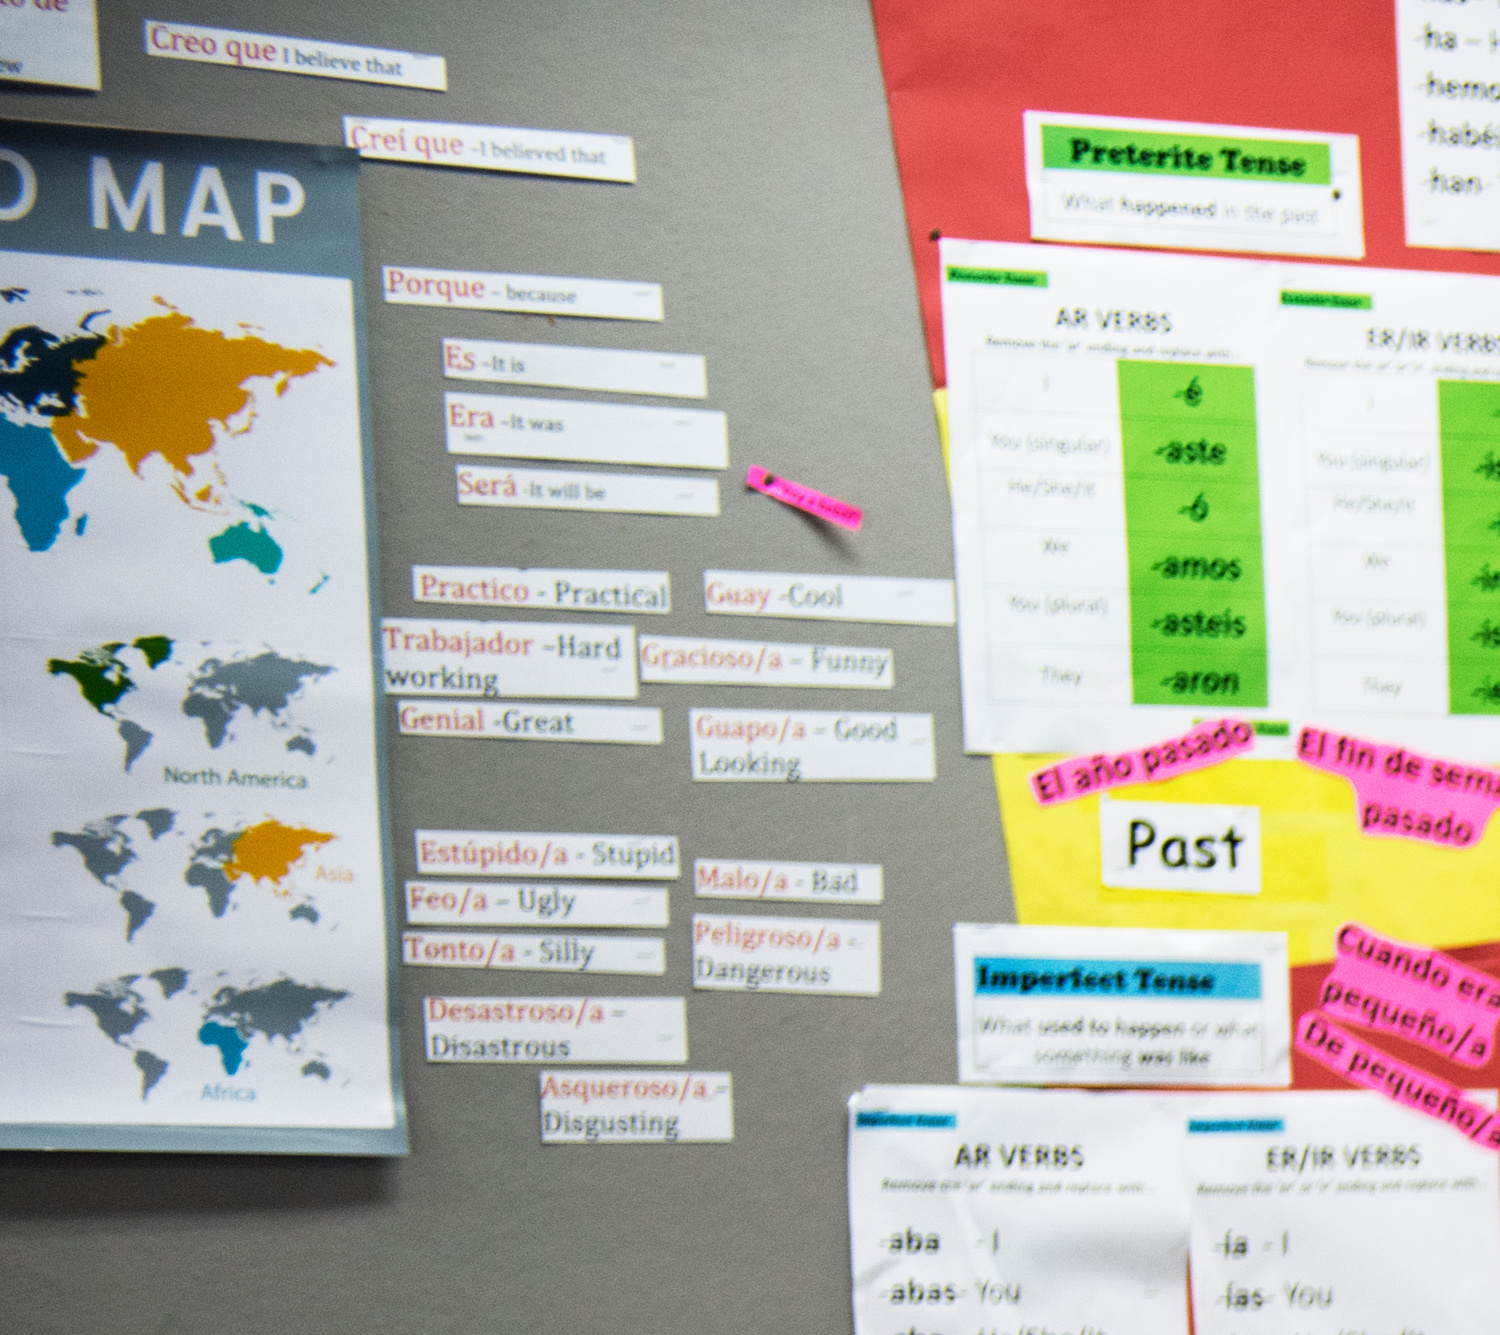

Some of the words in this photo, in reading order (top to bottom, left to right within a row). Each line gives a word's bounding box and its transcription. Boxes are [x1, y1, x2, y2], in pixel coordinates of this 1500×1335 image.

[149, 25, 216, 55] Creo
[226, 39, 277, 66] que
[283, 47, 289, 63] I
[296, 49, 360, 72] believe
[365, 57, 403, 76] that
[351, 126, 407, 152] Creí
[415, 134, 463, 159] que
[494, 139, 567, 164] believed
[569, 143, 606, 166] that
[1070, 137, 1212, 173] Preterite
[1221, 145, 1308, 178] Tense
[90, 154, 306, 245] MAP
[386, 269, 486, 303] Porque
[505, 283, 577, 304] because
[1056, 306, 1092, 332] AR
[1097, 308, 1173, 335] VERBS
[1365, 326, 1430, 356] ER/IR
[445, 344, 476, 371] Es
[510, 356, 525, 373] is
[450, 403, 495, 428] Era
[530, 416, 564, 432] was
[457, 470, 518, 498] Será
[548, 484, 580, 501] will
[585, 486, 606, 501] be
[420, 573, 530, 602] Practico
[554, 580, 666, 608] Practical
[707, 578, 771, 613] Guay
[382, 626, 534, 660] Trabajador
[641, 642, 782, 675] Gracioso/a
[812, 647, 889, 679] Funny
[385, 664, 499, 696] working
[400, 706, 484, 731] Genial
[696, 714, 806, 744] Guapo/a
[834, 716, 897, 742] Good
[700, 751, 802, 782] Looking
[1035, 768, 1066, 802] El
[1072, 752, 1134, 791] año
[1142, 720, 1254, 785] pasado
[1302, 728, 1332, 760] El
[1338, 736, 1374, 768] fin
[1385, 746, 1422, 779] de
[164, 764, 216, 788] North
[225, 766, 308, 791] America
[1360, 799, 1474, 846] pasado
[419, 838, 569, 870] Estúpido/a
[592, 841, 676, 871] Stupid
[1126, 817, 1246, 871] Past
[314, 862, 356, 885] Asia
[696, 864, 788, 898] Malo/a
[811, 869, 858, 896] Bad
[409, 886, 488, 917] Feo/a
[518, 888, 576, 917] Ugly
[404, 935, 516, 968] Tonto/a
[538, 938, 594, 972] Silly
[693, 920, 842, 958] Peligroso/a
[1337, 926, 1452, 983] Cuando
[695, 958, 832, 989] Dangerous
[977, 964, 1124, 996] Imperfect
[1134, 968, 1214, 994] Tense
[427, 996, 604, 1027] Desastroso/a
[1321, 979, 1489, 1060] pequeño/a
[431, 1034, 571, 1059] Disastrous
[1304, 1018, 1346, 1052] De
[200, 1081, 258, 1103] Africa
[541, 1072, 708, 1105] Asqueroso/a
[542, 1110, 679, 1142] Disgusting
[954, 1143, 991, 1168] AR
[1000, 1145, 1085, 1169] VERBS
[1265, 1145, 1336, 1172] ER/IR
[1342, 1145, 1421, 1169] VERBS
[974, 1279, 1022, 1305] You
